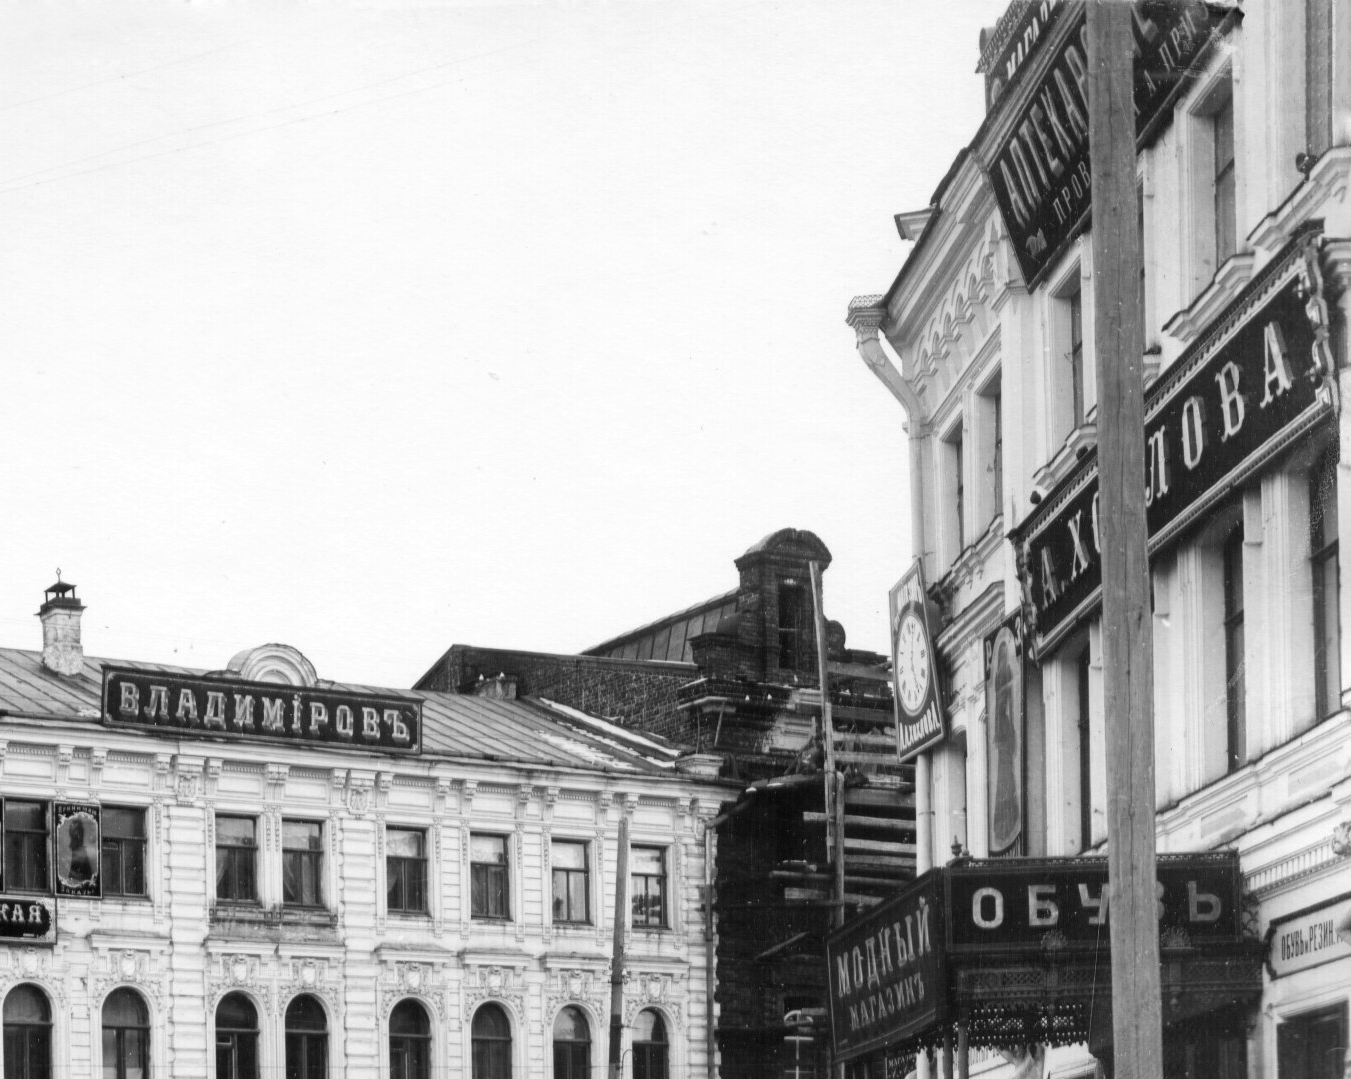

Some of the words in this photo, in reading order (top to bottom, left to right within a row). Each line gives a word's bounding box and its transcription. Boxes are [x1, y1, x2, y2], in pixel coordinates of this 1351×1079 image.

[119, 681, 410, 742] ВЛАДИМІРОВЪ
[837, 896, 931, 998] МОДНЫЙ
[849, 972, 924, 1031] МАГАЗИНЪ
